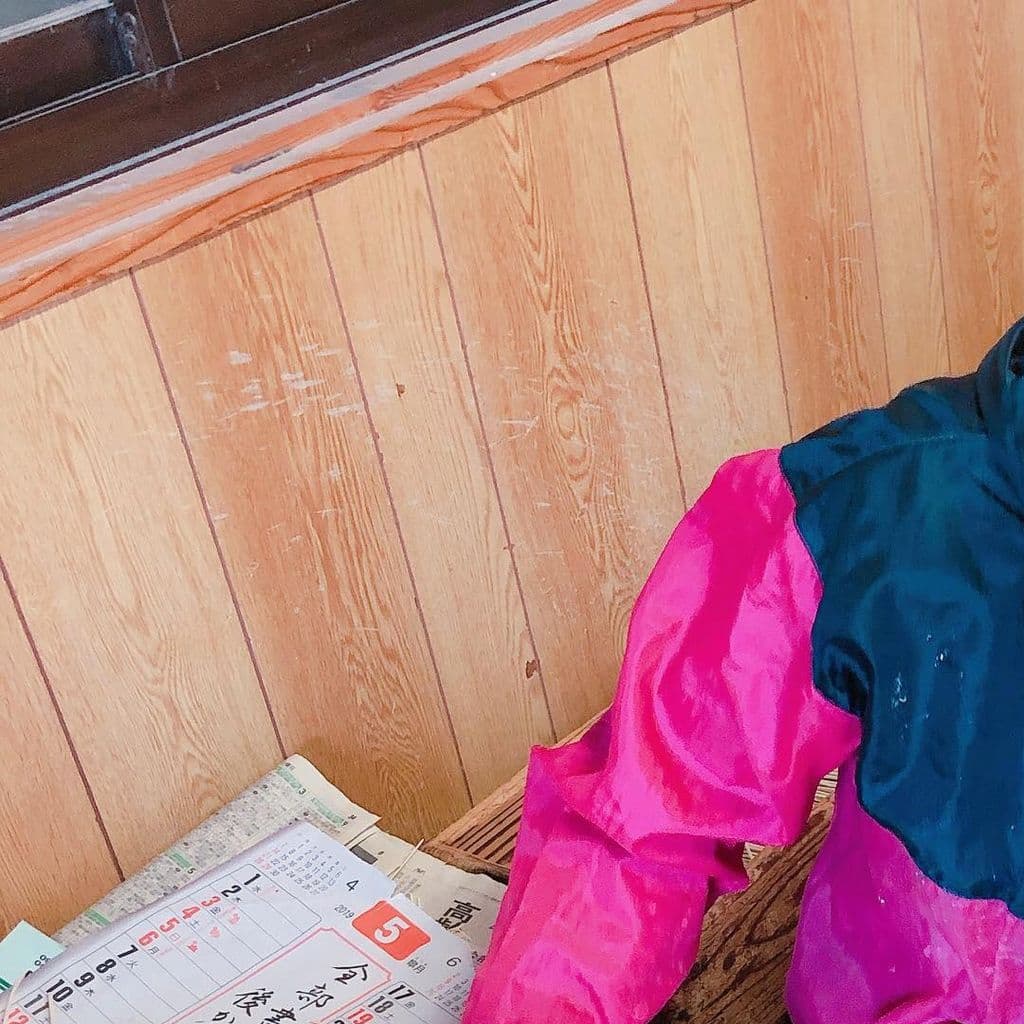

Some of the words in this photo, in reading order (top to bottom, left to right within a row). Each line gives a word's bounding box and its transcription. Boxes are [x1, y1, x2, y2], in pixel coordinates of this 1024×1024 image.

[244, 873, 262, 886] 1
[346, 879, 360, 893] 4
[221, 885, 242, 898] 2
[201, 896, 222, 907] 3
[182, 906, 201, 920] 4
[333, 903, 355, 920] 2019
[160, 917, 181, 933] 5
[373, 917, 412, 946] 5
[138, 930, 160, 946] 6
[118, 944, 139, 959] 7
[96, 958, 117, 974] 8
[446, 957, 462, 968] 6
[74, 971, 96, 988] 9
[46, 978, 74, 1003] 10
[388, 984, 416, 1001] 17
[24, 994, 50, 1016] 11
[366, 995, 394, 1014] 18
